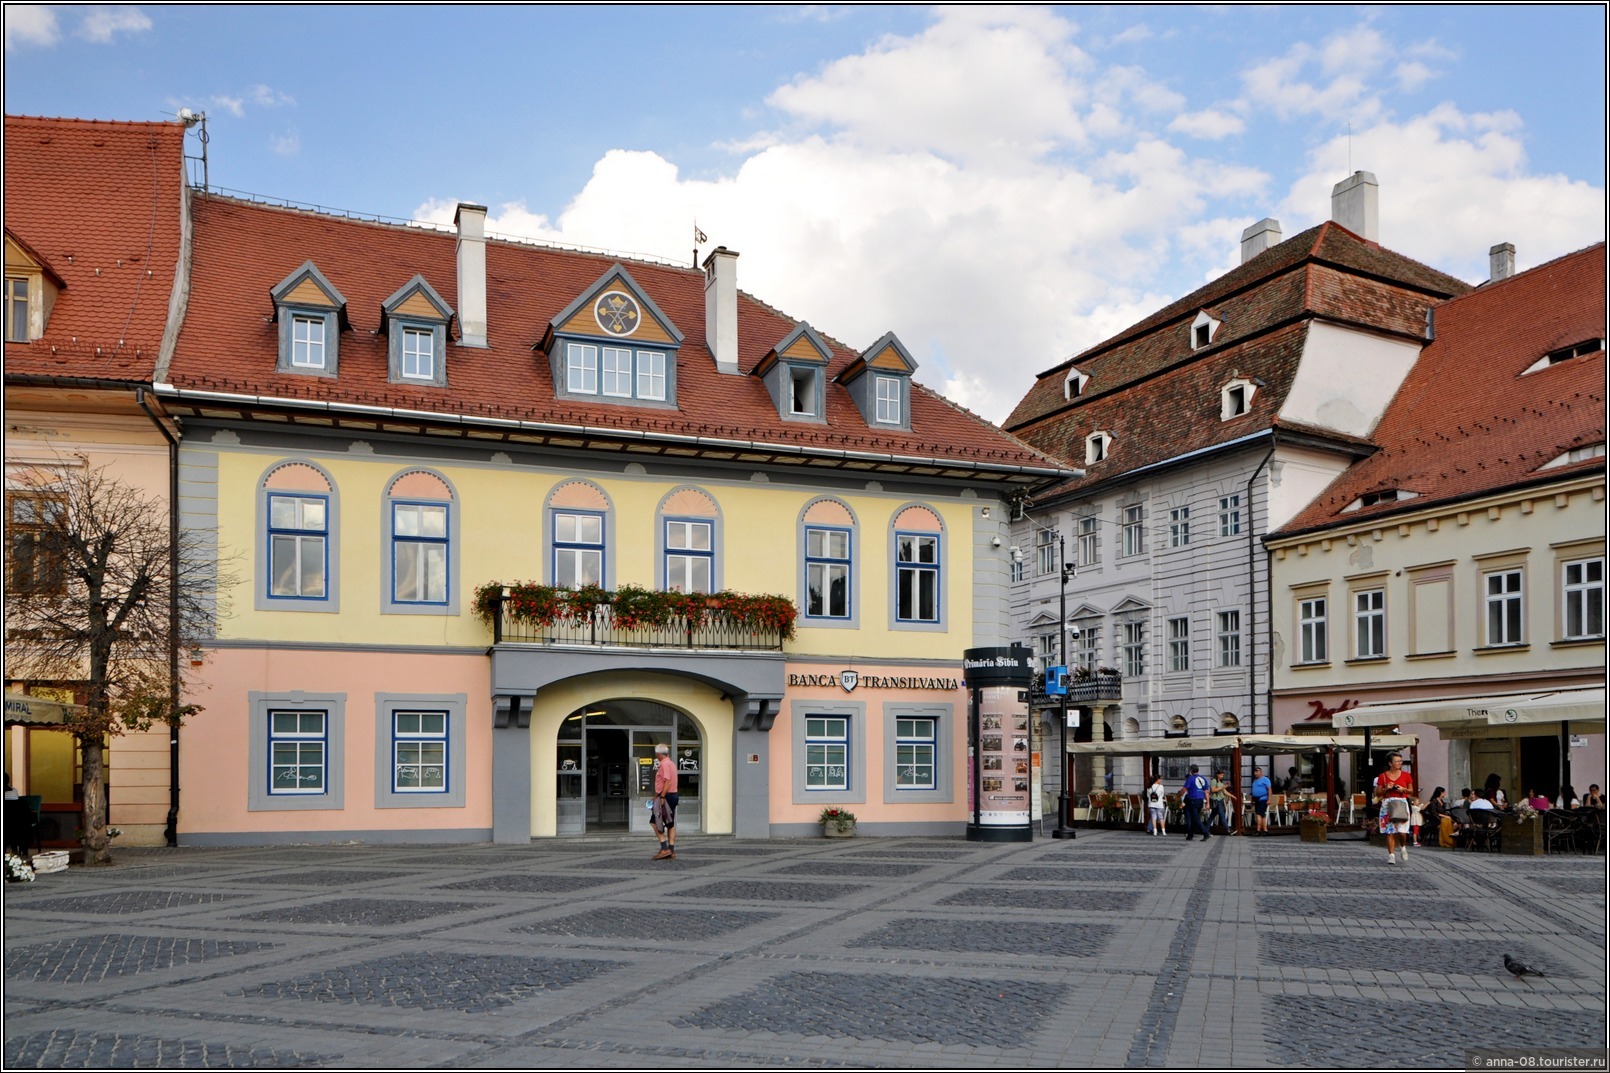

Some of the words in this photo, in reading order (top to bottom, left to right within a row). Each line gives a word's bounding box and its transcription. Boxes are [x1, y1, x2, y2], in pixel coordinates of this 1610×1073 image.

[995, 655, 1019, 667] Sibiu
[788, 673, 836, 687] BANCA
[844, 675, 854, 683] BT
[863, 675, 959, 690] TRANSILVANIA
